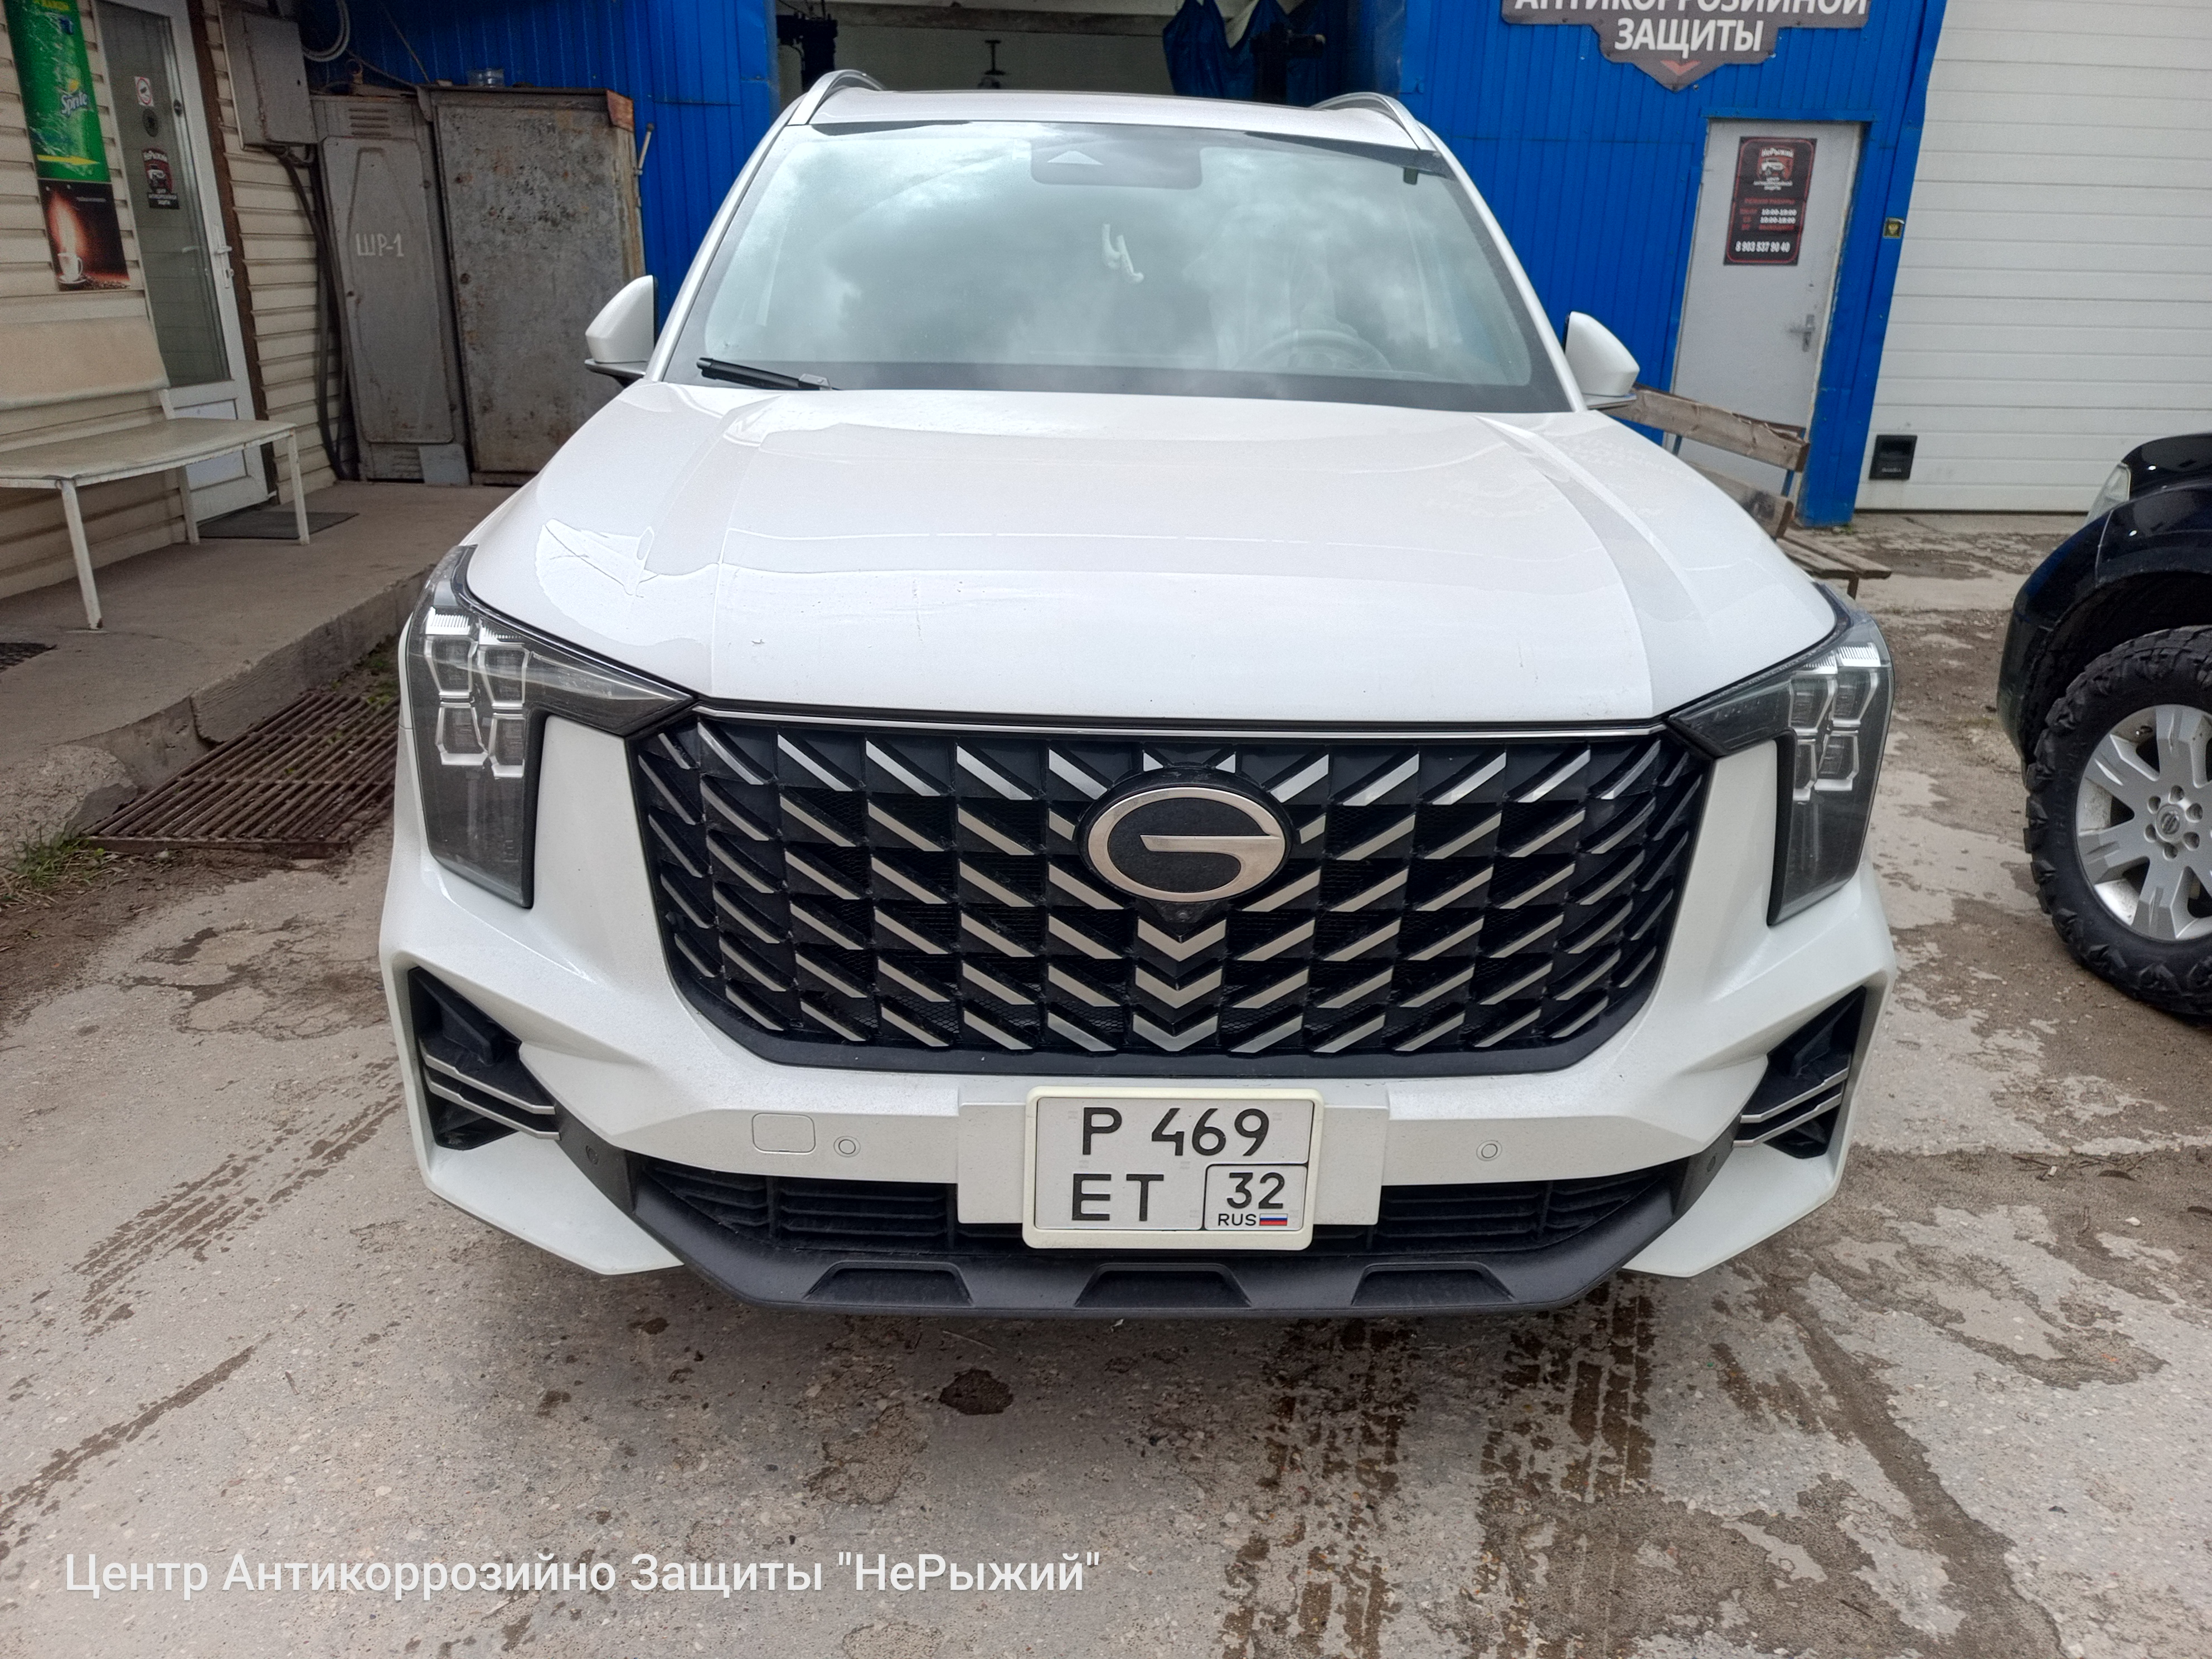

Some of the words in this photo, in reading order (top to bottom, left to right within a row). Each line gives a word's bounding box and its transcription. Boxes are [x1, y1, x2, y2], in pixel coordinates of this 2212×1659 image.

[1614, 17, 1764, 59] ЗАЩИТЫ
[61, 91, 88, 117] Sprite
[356, 233, 404, 256] ШР-1
[1151, 1108, 1270, 1157] 469
[1226, 1172, 1286, 1209] 32
[1217, 1213, 1257, 1226] RUS
